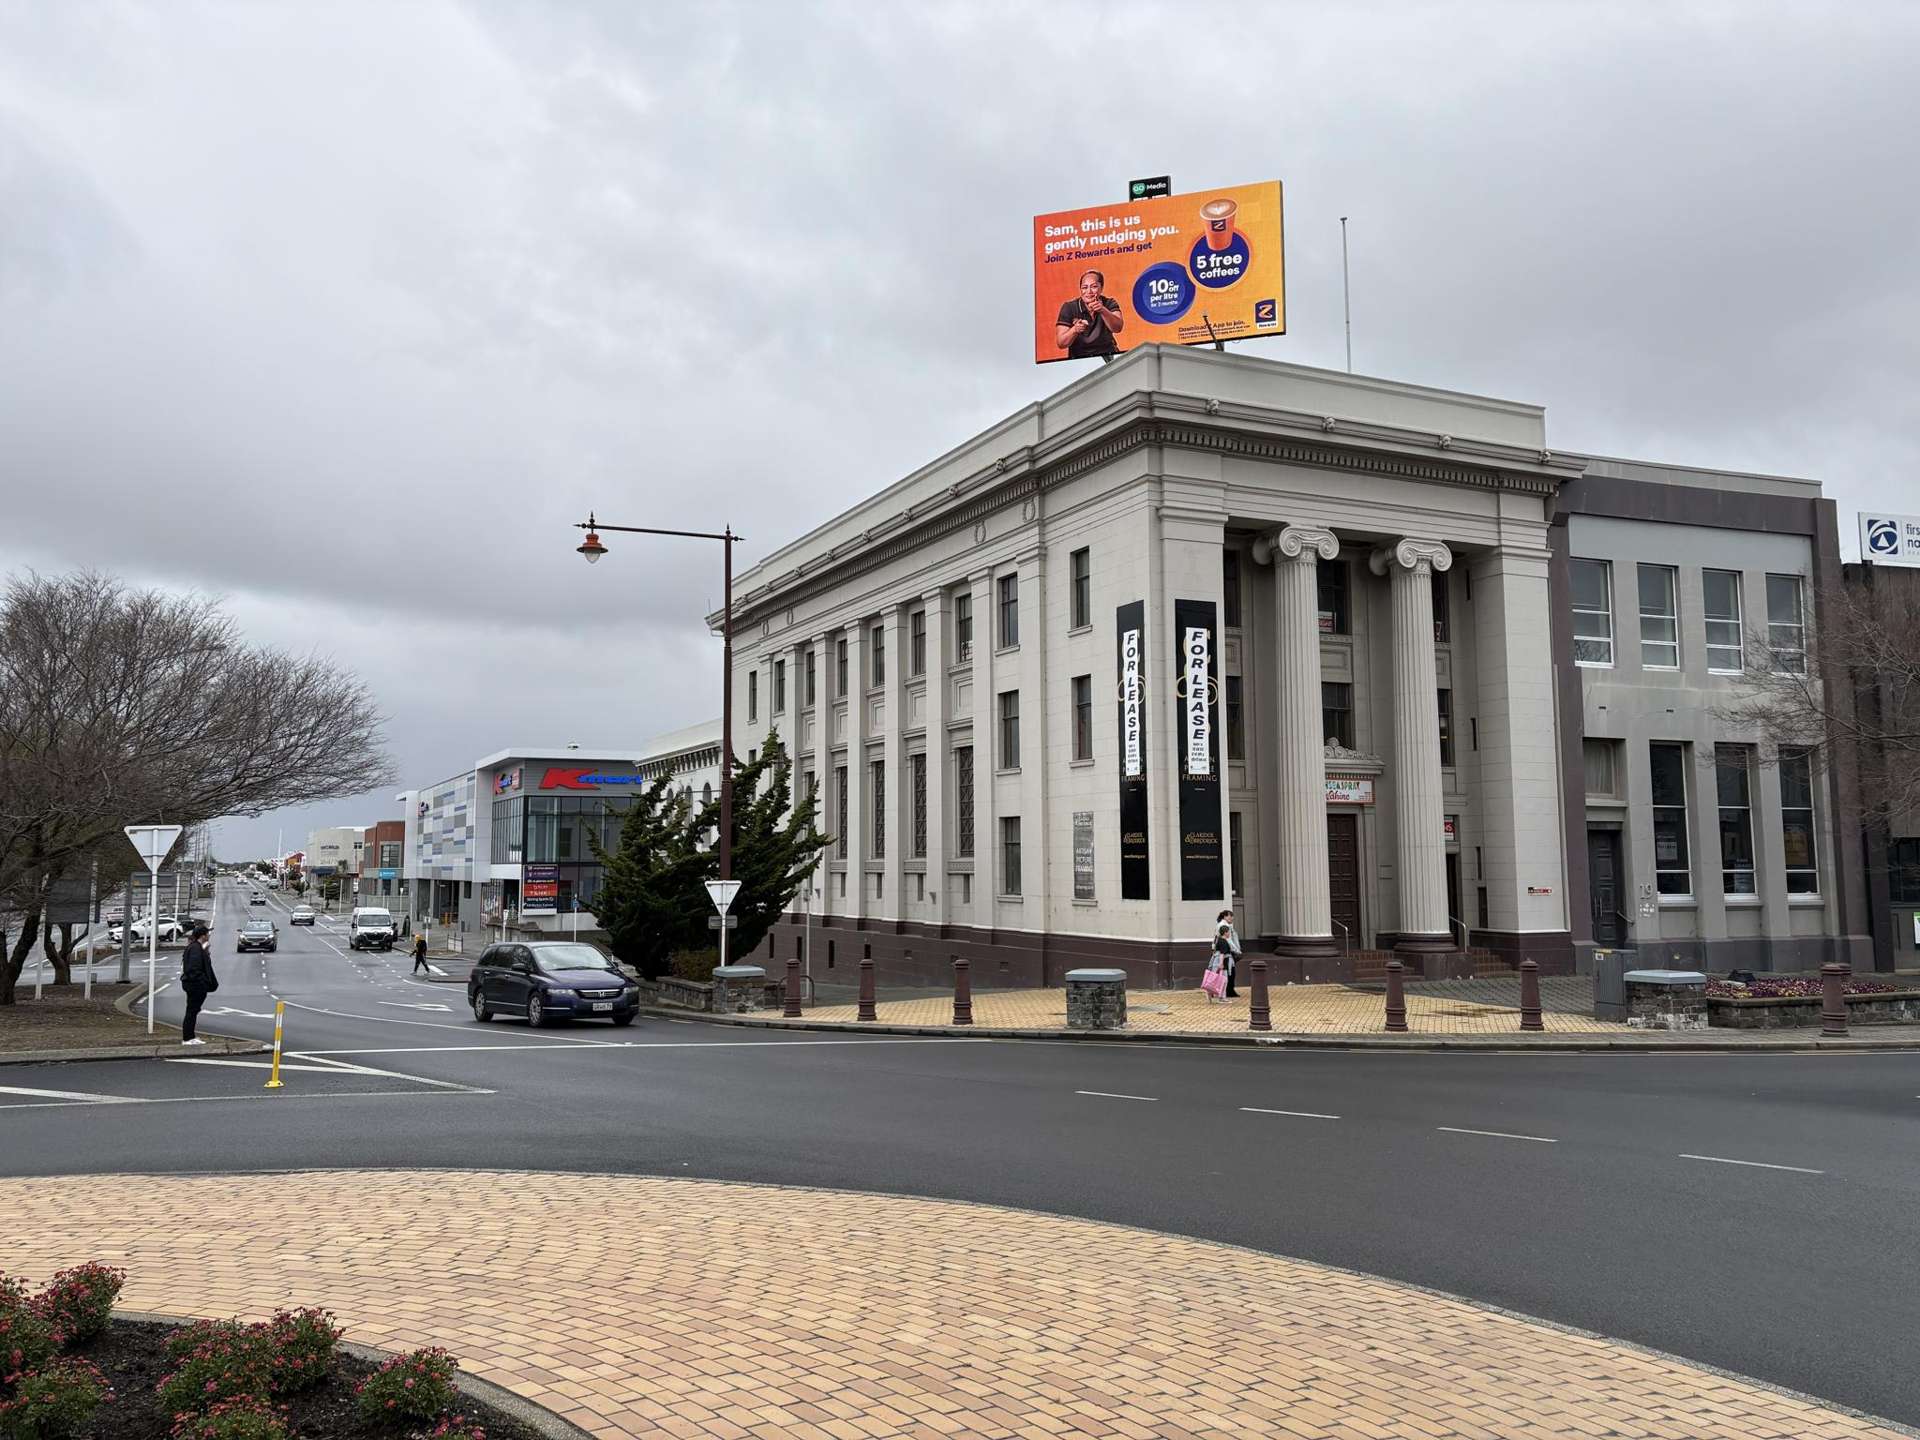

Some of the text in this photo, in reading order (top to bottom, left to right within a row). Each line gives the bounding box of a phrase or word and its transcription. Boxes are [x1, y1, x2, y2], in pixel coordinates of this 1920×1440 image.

[1146, 181, 1167, 191] Media
[1045, 215, 1141, 238] Sam, this is us
[1045, 225, 1180, 255] gently nudging you.
[1045, 241, 1153, 264] Join Z Rewards and get
[1196, 253, 1243, 269] 5 free
[1199, 267, 1241, 280] coffees
[1150, 292, 1178, 304] per litre
[1258, 303, 1274, 319] Z
[1126, 633, 1136, 672] FOR
[1190, 631, 1205, 669] FOR
[1127, 677, 1137, 742] LEASE
[1190, 674, 1206, 740] LEASE
[1182, 774, 1218, 782] FRAMING
